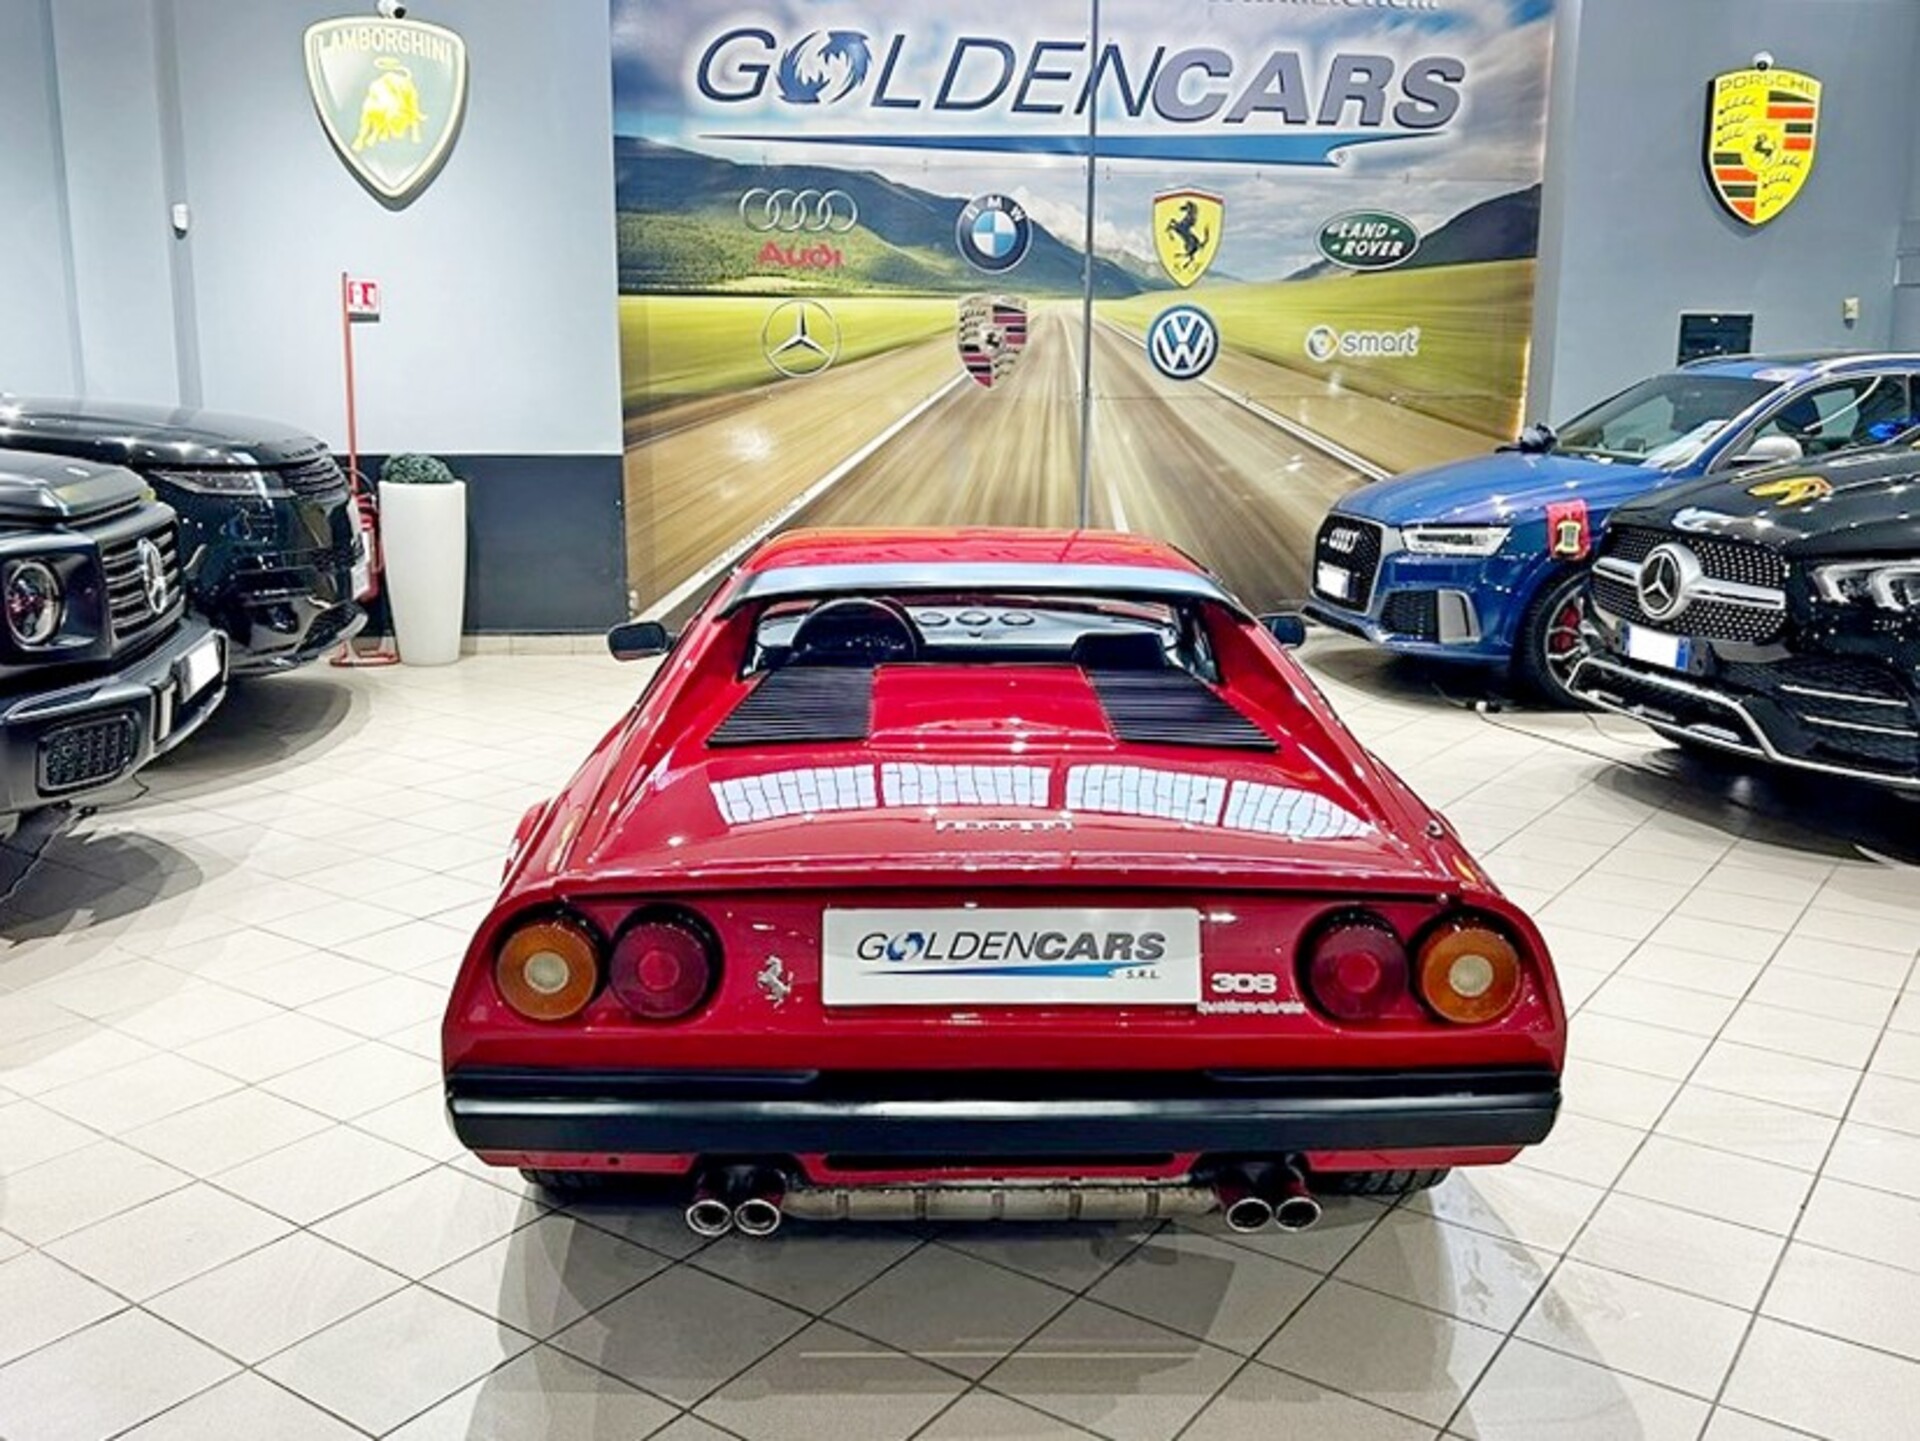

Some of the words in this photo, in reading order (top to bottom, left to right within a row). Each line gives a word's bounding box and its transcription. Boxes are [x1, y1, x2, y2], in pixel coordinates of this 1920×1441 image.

[313, 26, 451, 64] LAMBORGHINI
[1719, 73, 1818, 98] PORSCHE
[1338, 222, 1389, 239] LAND
[758, 240, 845, 268] Audi
[1341, 240, 1403, 257] ROVER
[1341, 328, 1417, 354] smart
[1211, 972, 1277, 993] 308
